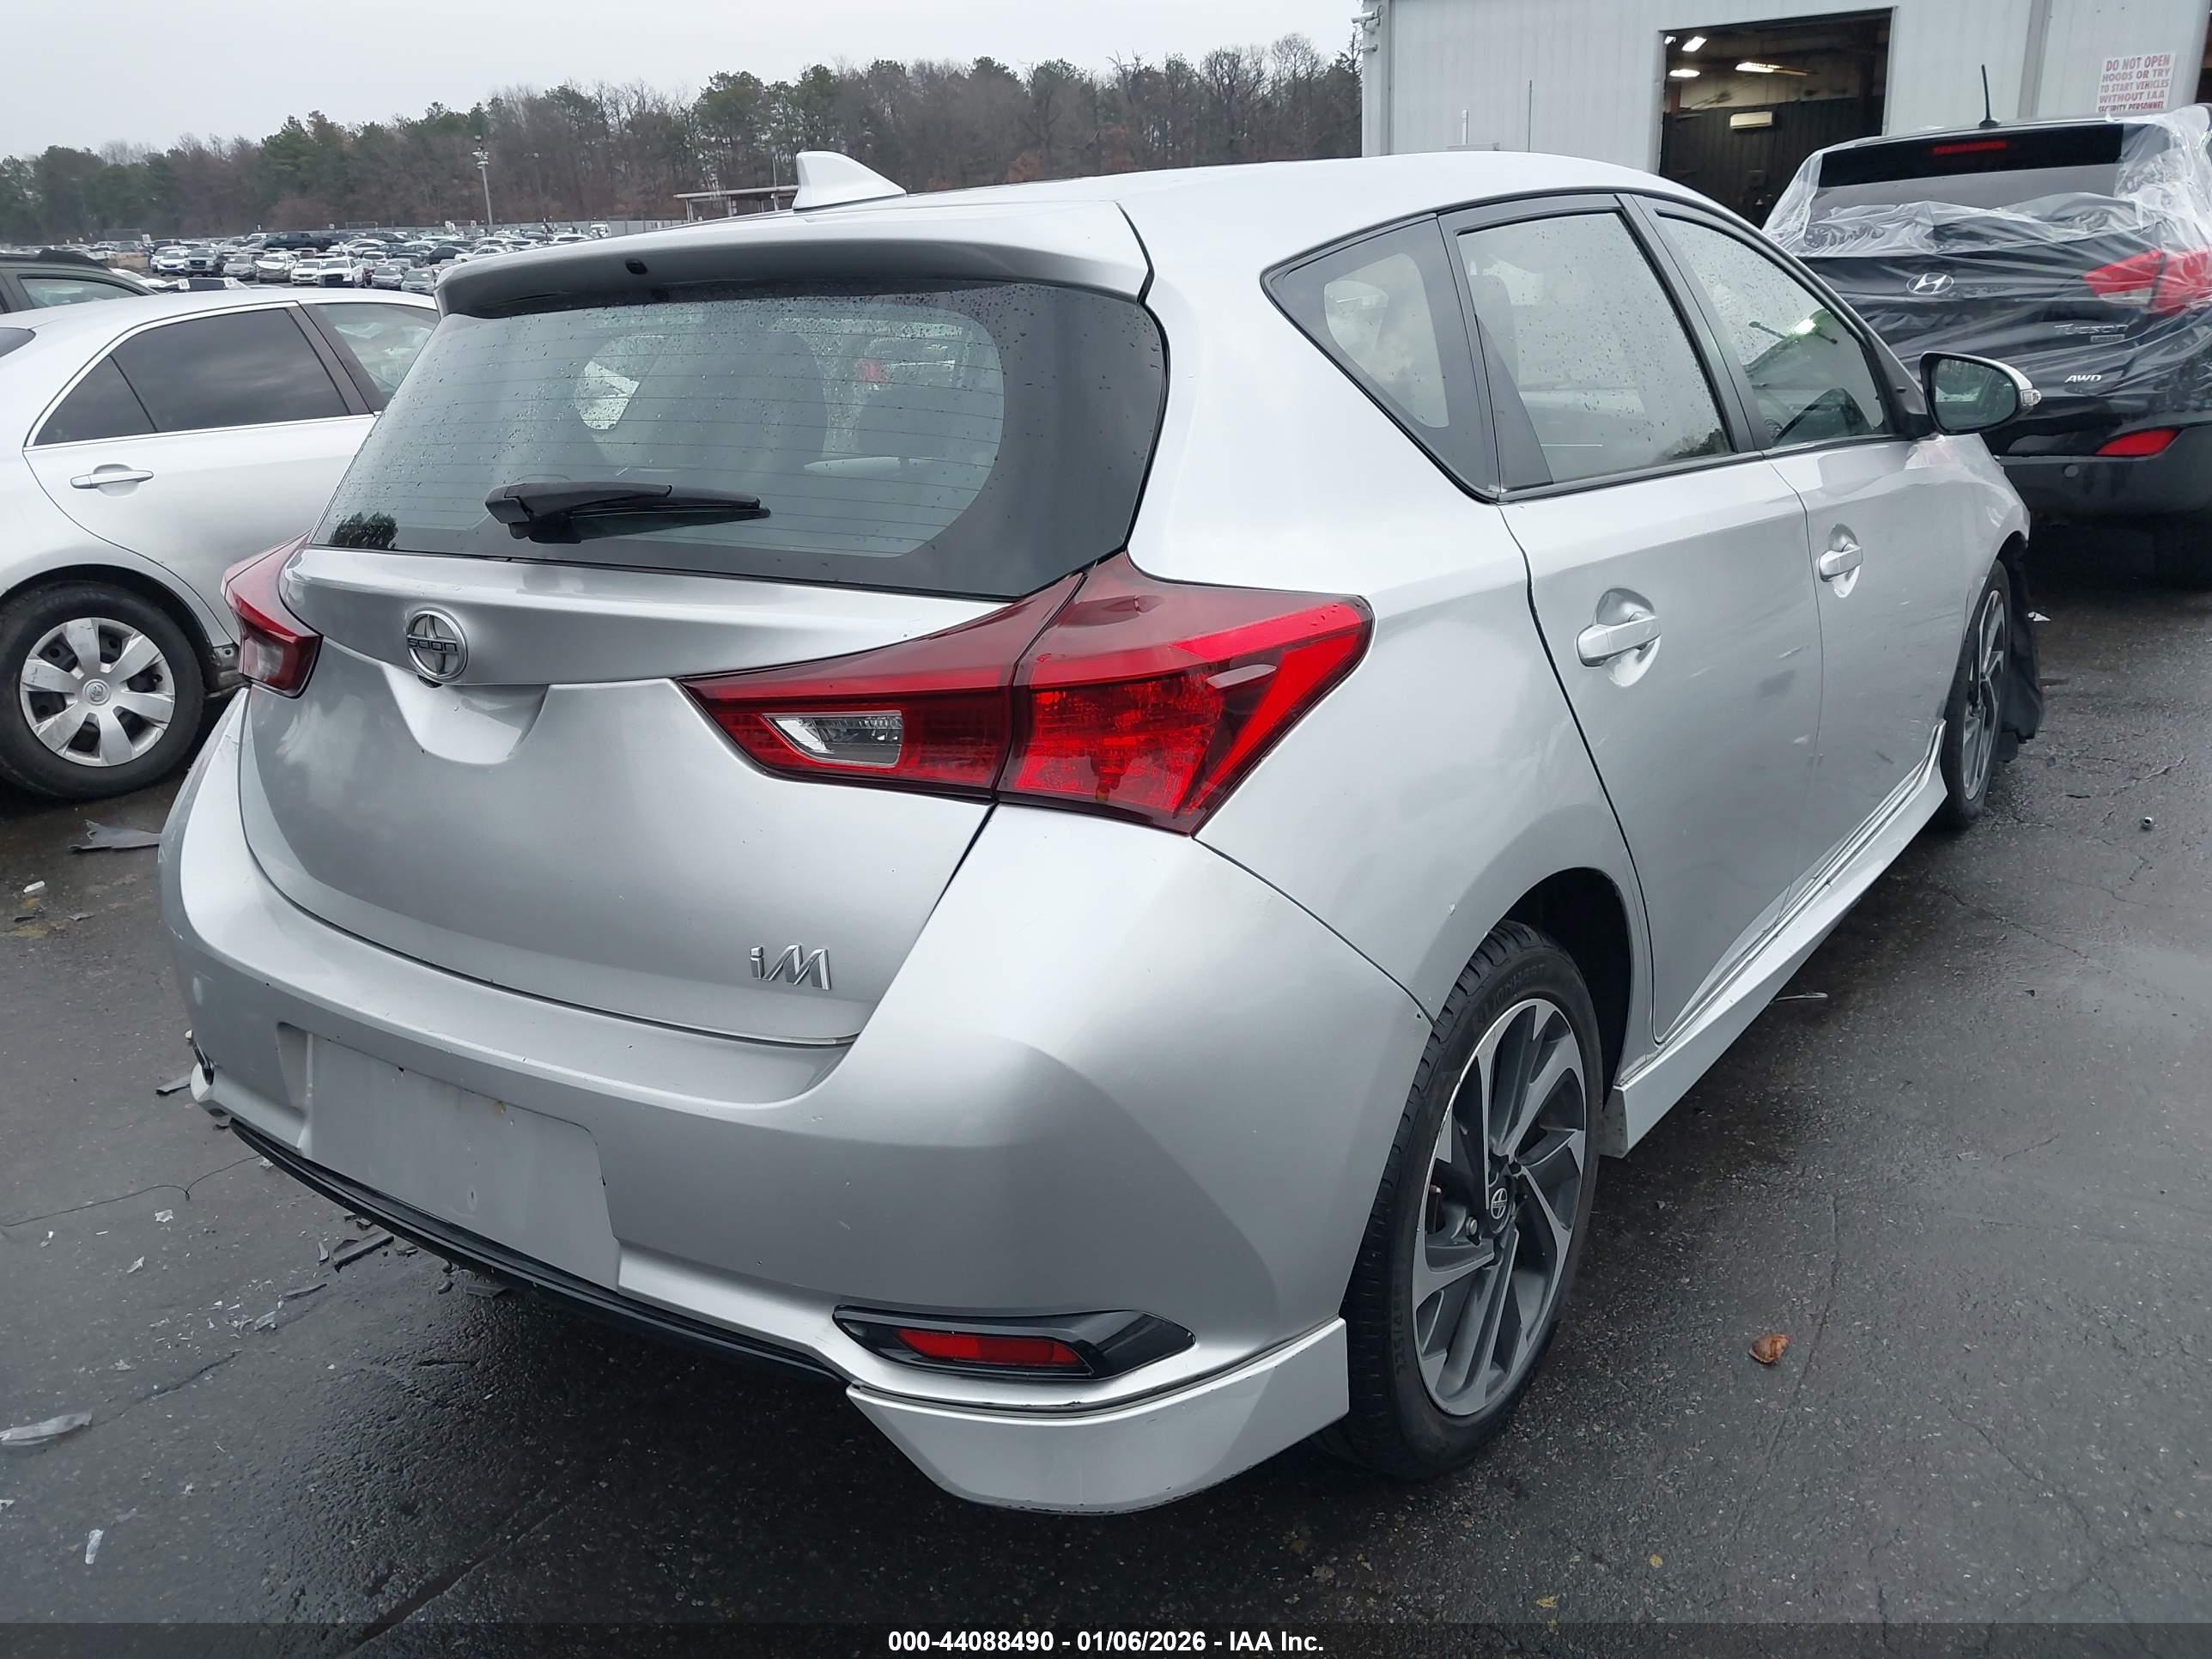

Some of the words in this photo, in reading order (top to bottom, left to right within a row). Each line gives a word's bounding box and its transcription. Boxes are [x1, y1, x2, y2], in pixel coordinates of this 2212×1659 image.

[2106, 59, 2119, 71] DO
[2123, 57, 2142, 70] NOT
[2144, 54, 2171, 68] OPEN
[2102, 71, 2133, 82] HOODS
[2136, 70, 2149, 79] OR
[2153, 68, 2170, 77] TRY
[2101, 84, 2110, 93] TO
[2111, 82, 2134, 92] START
[2136, 79, 2170, 90] VEHICLES
[2100, 92, 2144, 103] WITHOUT
[2147, 90, 2164, 100] IAA
[2129, 101, 2164, 110] PERSONNEL
[2064, 374, 2102, 383] AWD
[750, 945, 832, 990] iM
